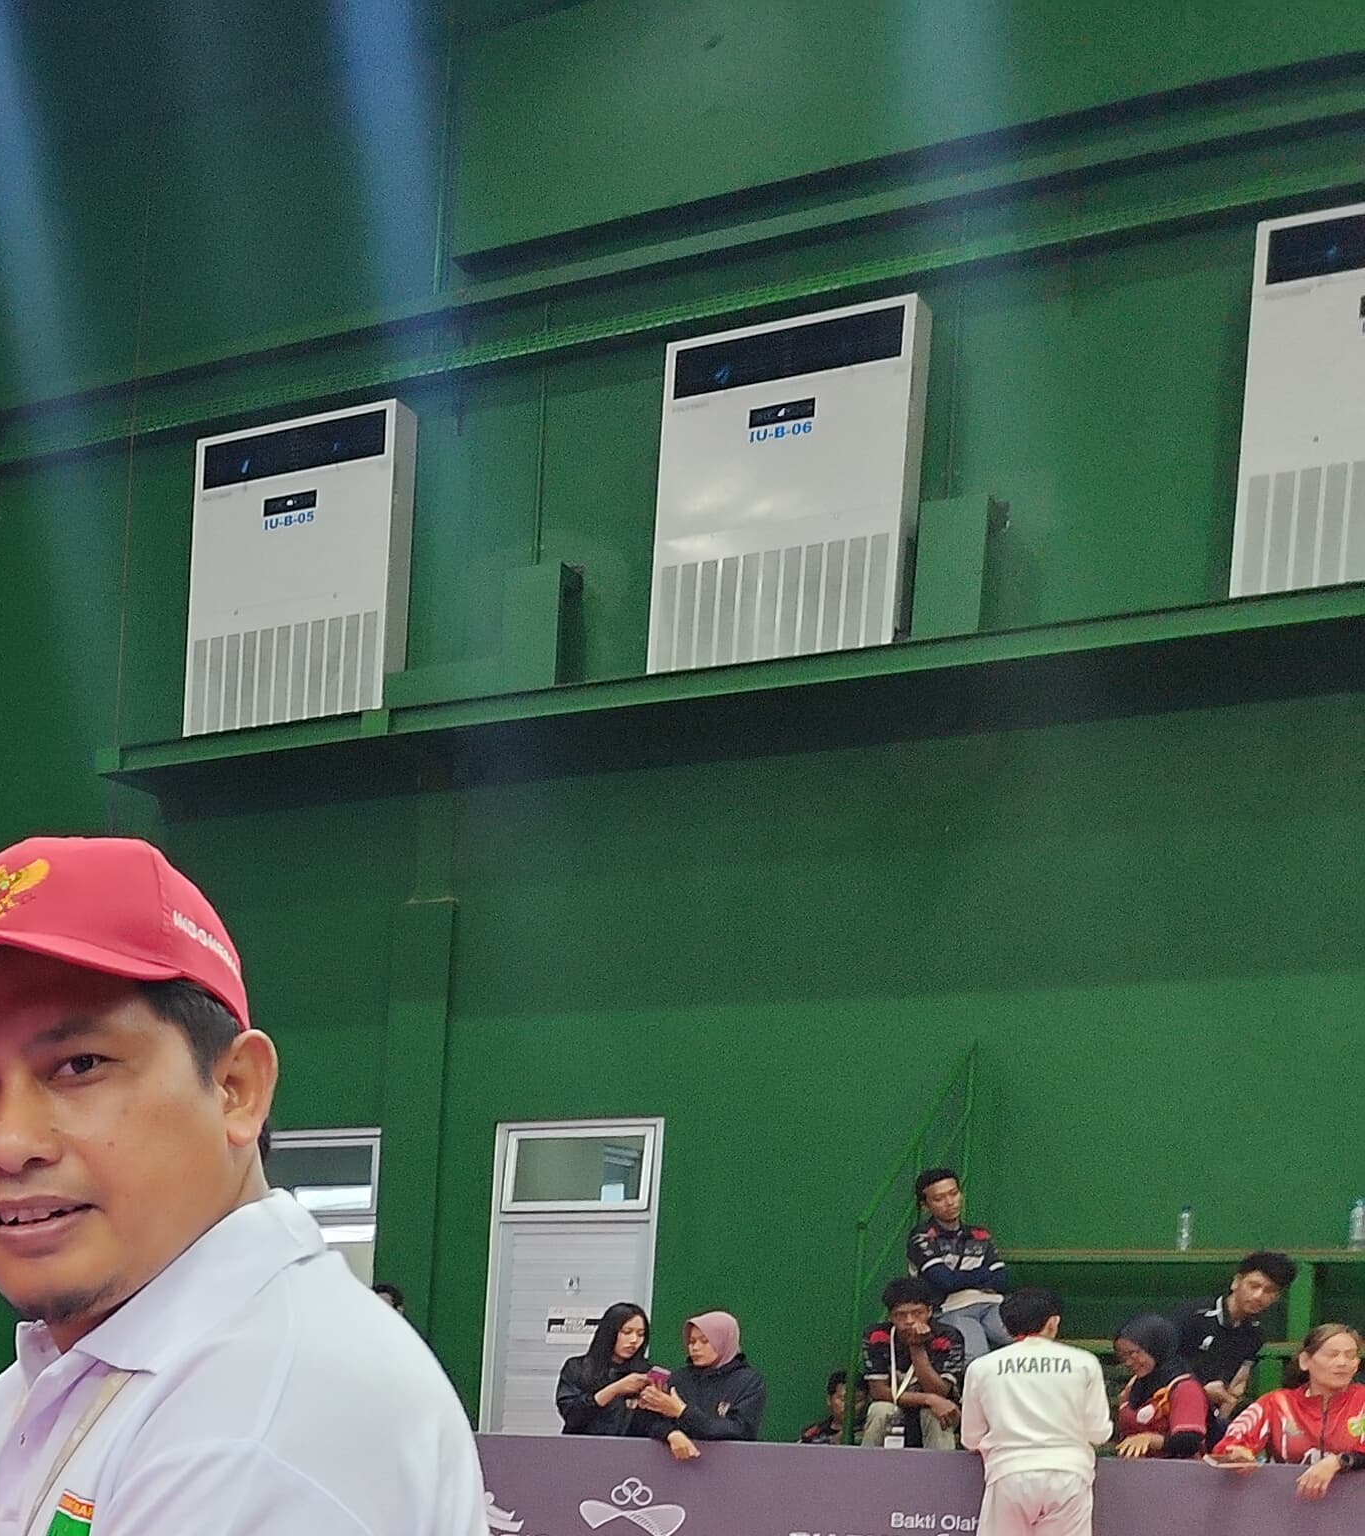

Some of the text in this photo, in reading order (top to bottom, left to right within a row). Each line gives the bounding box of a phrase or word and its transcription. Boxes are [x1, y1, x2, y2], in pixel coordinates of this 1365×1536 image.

[750, 422, 812, 443] IU-B-06
[265, 511, 314, 530] IU-B-05
[997, 1357, 1072, 1375] JAKARTA
[891, 1512, 935, 1529] Bakti
